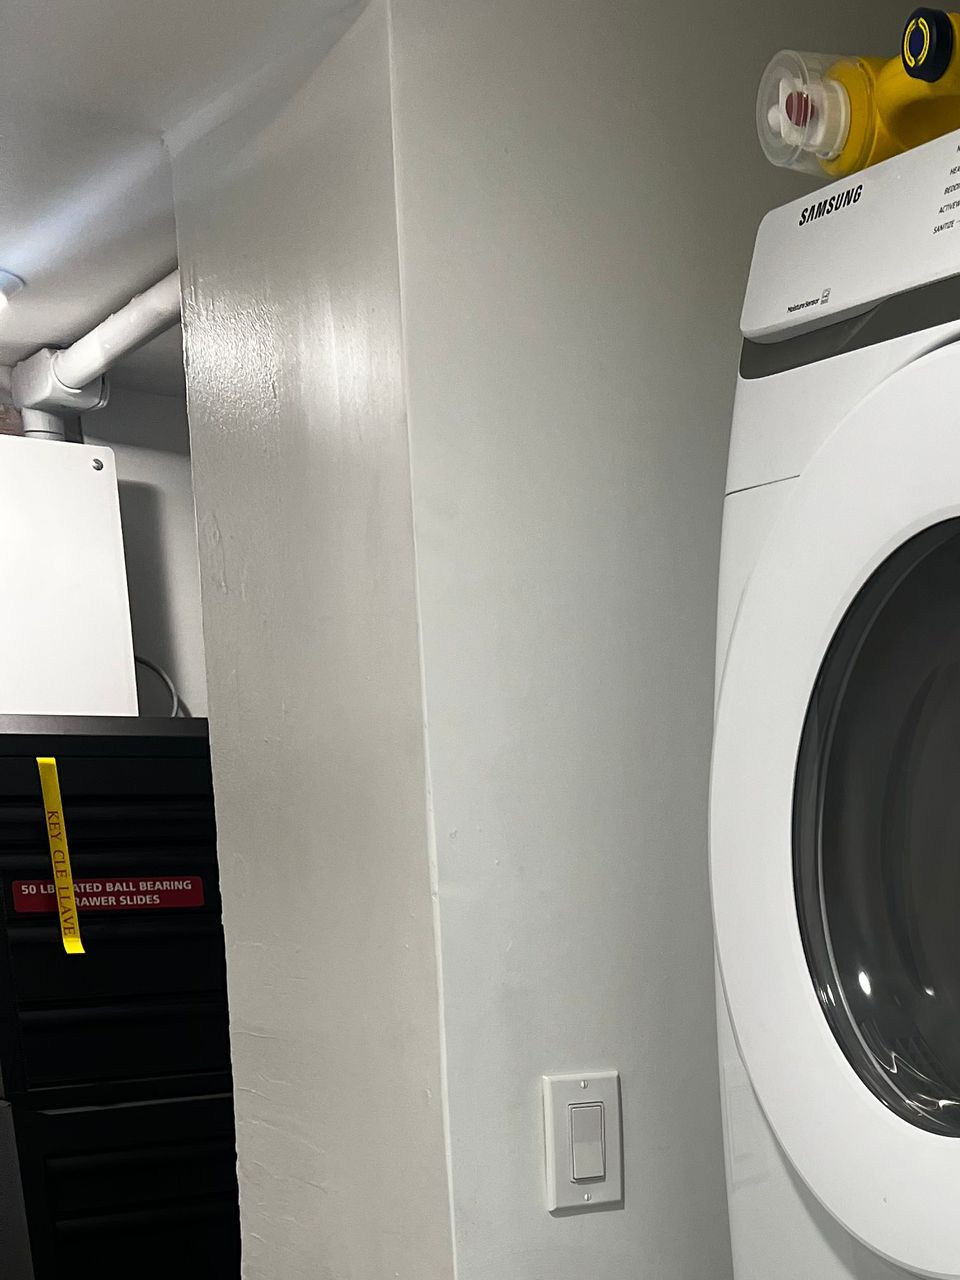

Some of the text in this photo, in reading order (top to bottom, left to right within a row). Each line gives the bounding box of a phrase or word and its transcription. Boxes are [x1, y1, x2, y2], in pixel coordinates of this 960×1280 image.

[799, 184, 862, 226] SAMSUNG
[22, 885, 36, 894] 50
[73, 883, 102, 892] ATED
[106, 882, 136, 892] BALL
[139, 880, 192, 891] BEARING
[47, 810, 62, 842] KEY
[58, 886, 76, 936] LLAVE
[75, 894, 160, 906] RAWER SLIDES
